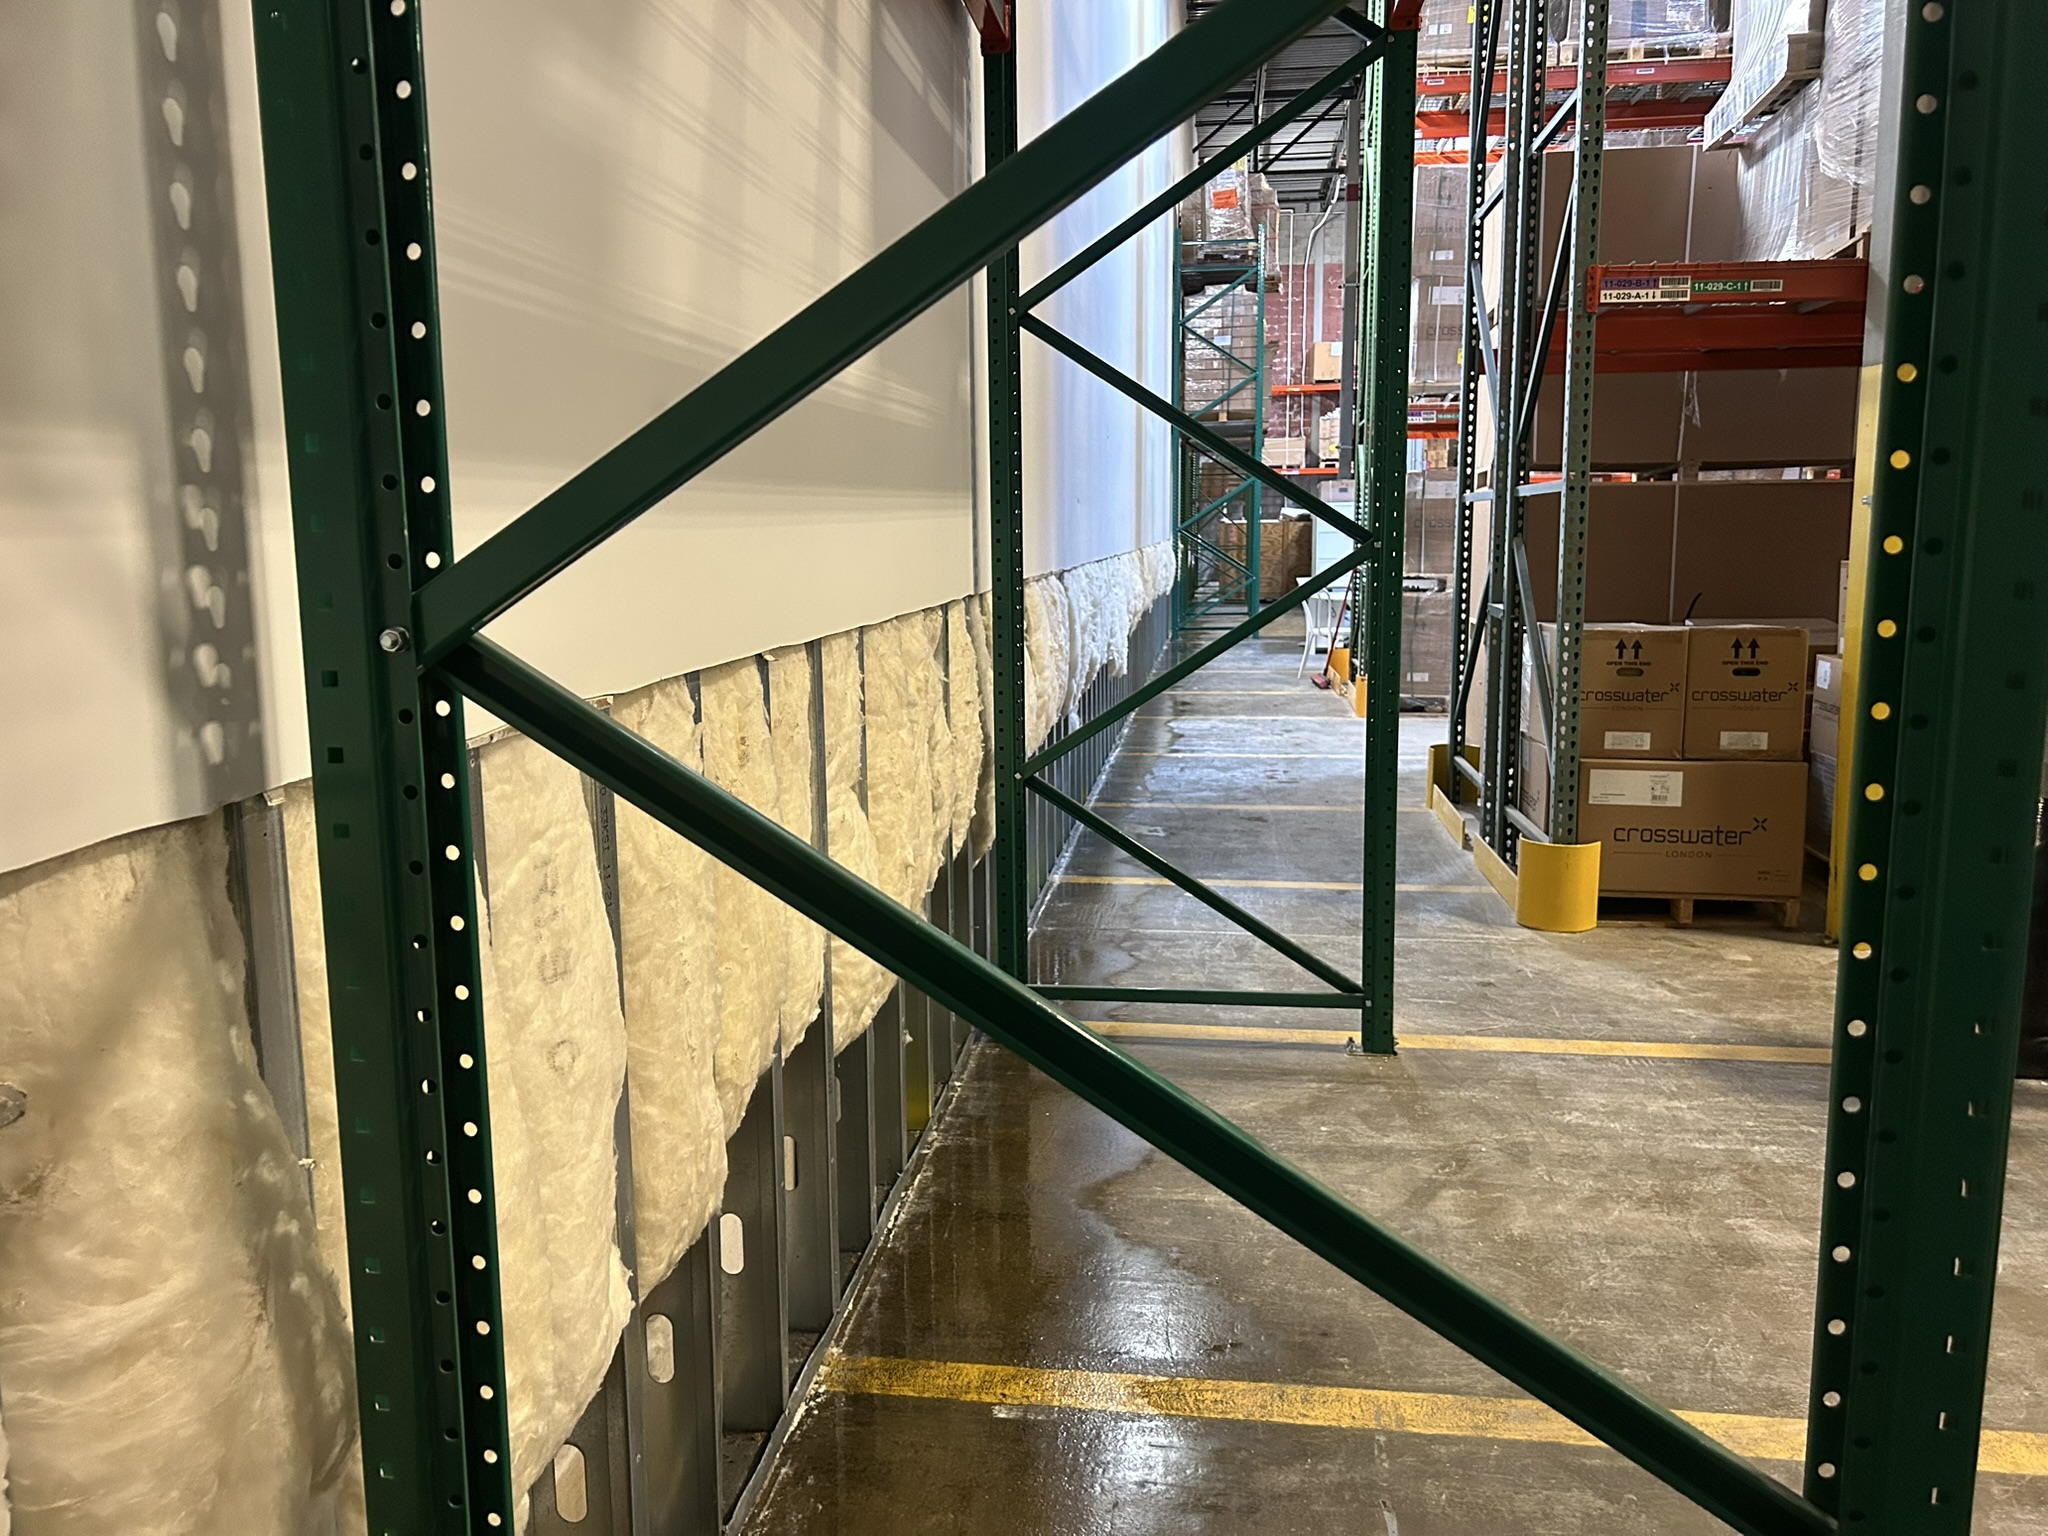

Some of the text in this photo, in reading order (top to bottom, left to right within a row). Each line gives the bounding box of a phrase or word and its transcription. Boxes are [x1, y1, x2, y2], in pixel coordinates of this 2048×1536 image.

[1604, 279, 1650, 288] 11-029-B-1
[1694, 282, 1741, 291] 11-029-C-1
[1603, 292, 1649, 300] 11-029-A-1
[1691, 688, 1787, 703] crosswater
[1613, 825, 1752, 846] crosswater
[1665, 850, 1712, 858] LONDON
